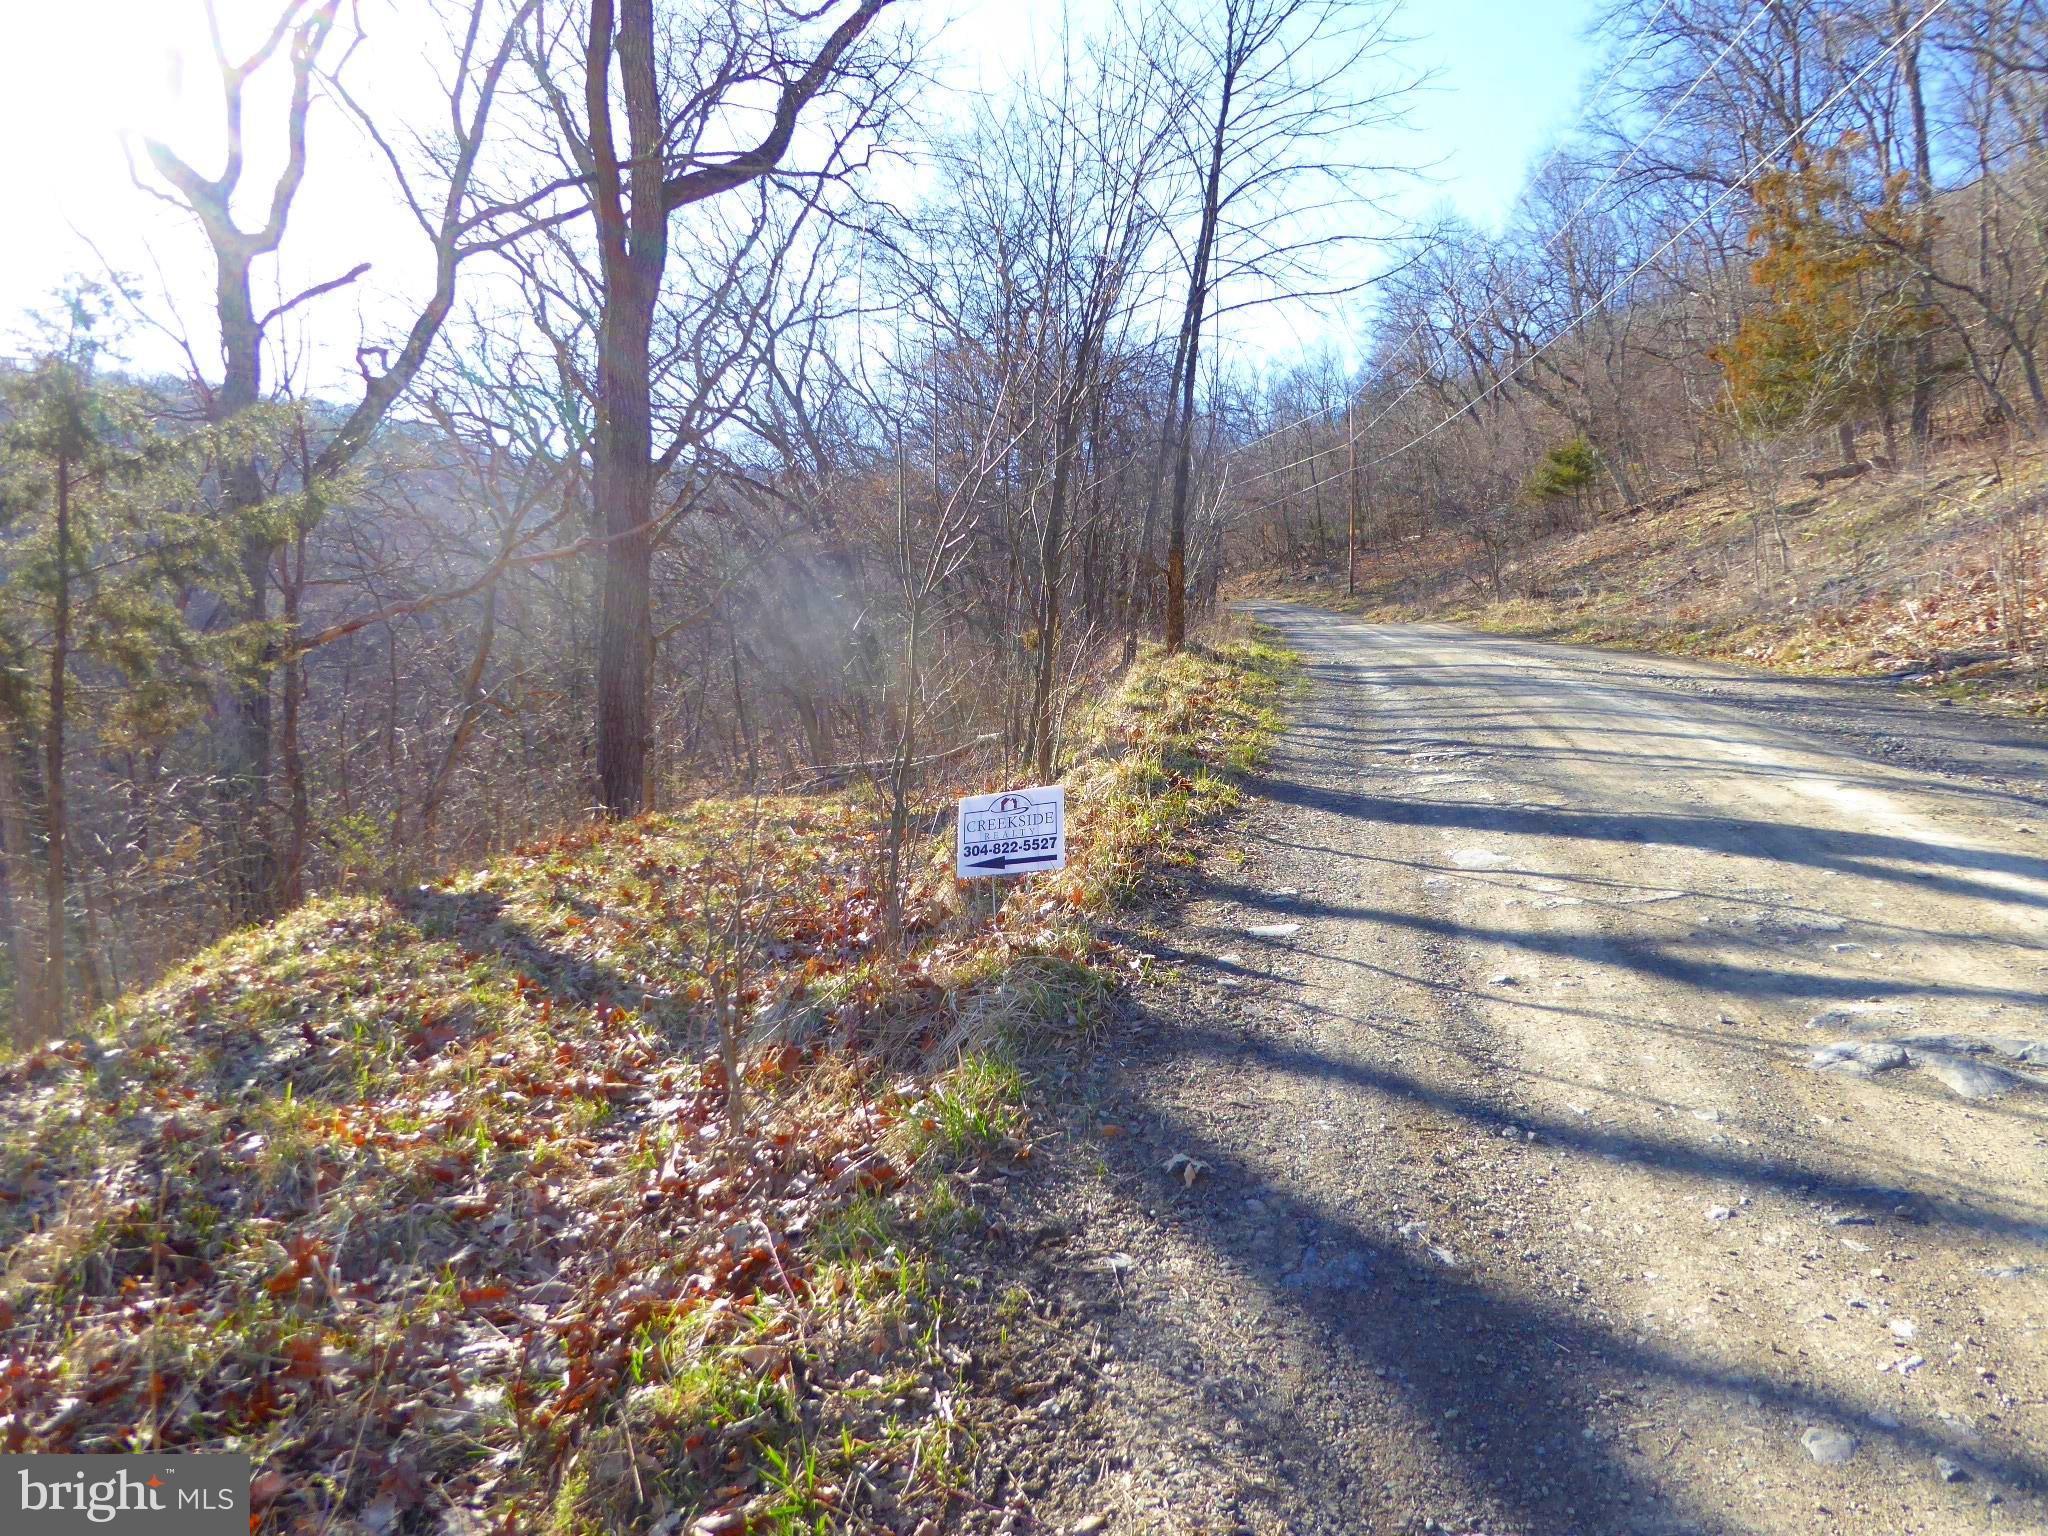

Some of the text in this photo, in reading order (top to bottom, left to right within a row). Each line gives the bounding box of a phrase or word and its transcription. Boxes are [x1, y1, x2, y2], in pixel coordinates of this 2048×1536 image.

[966, 811, 1054, 833] CREEKSIDE
[984, 827, 1035, 841] REALTY
[963, 837, 1058, 858] 304-822-5527
